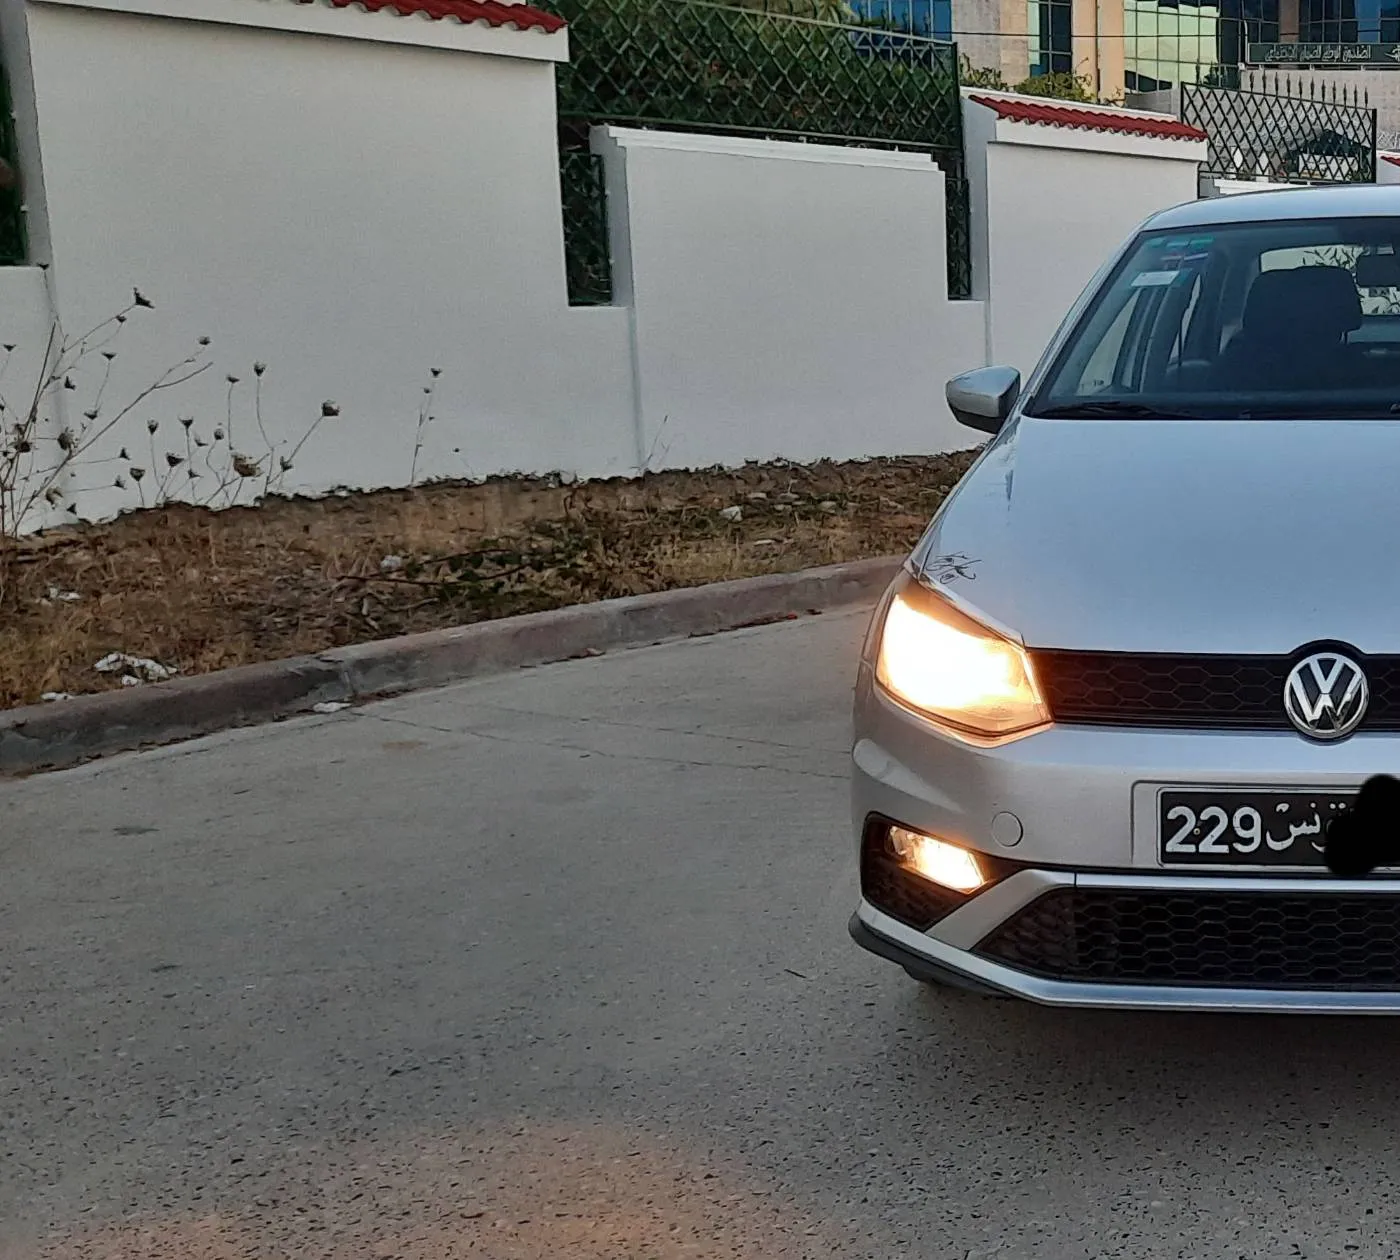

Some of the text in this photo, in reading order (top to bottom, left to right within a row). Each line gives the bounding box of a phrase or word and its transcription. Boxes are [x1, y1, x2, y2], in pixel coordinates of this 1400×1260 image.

[1286, 653, 1367, 735] VW
[1165, 805, 1261, 853] 229
[1266, 802, 1354, 851] تنس
